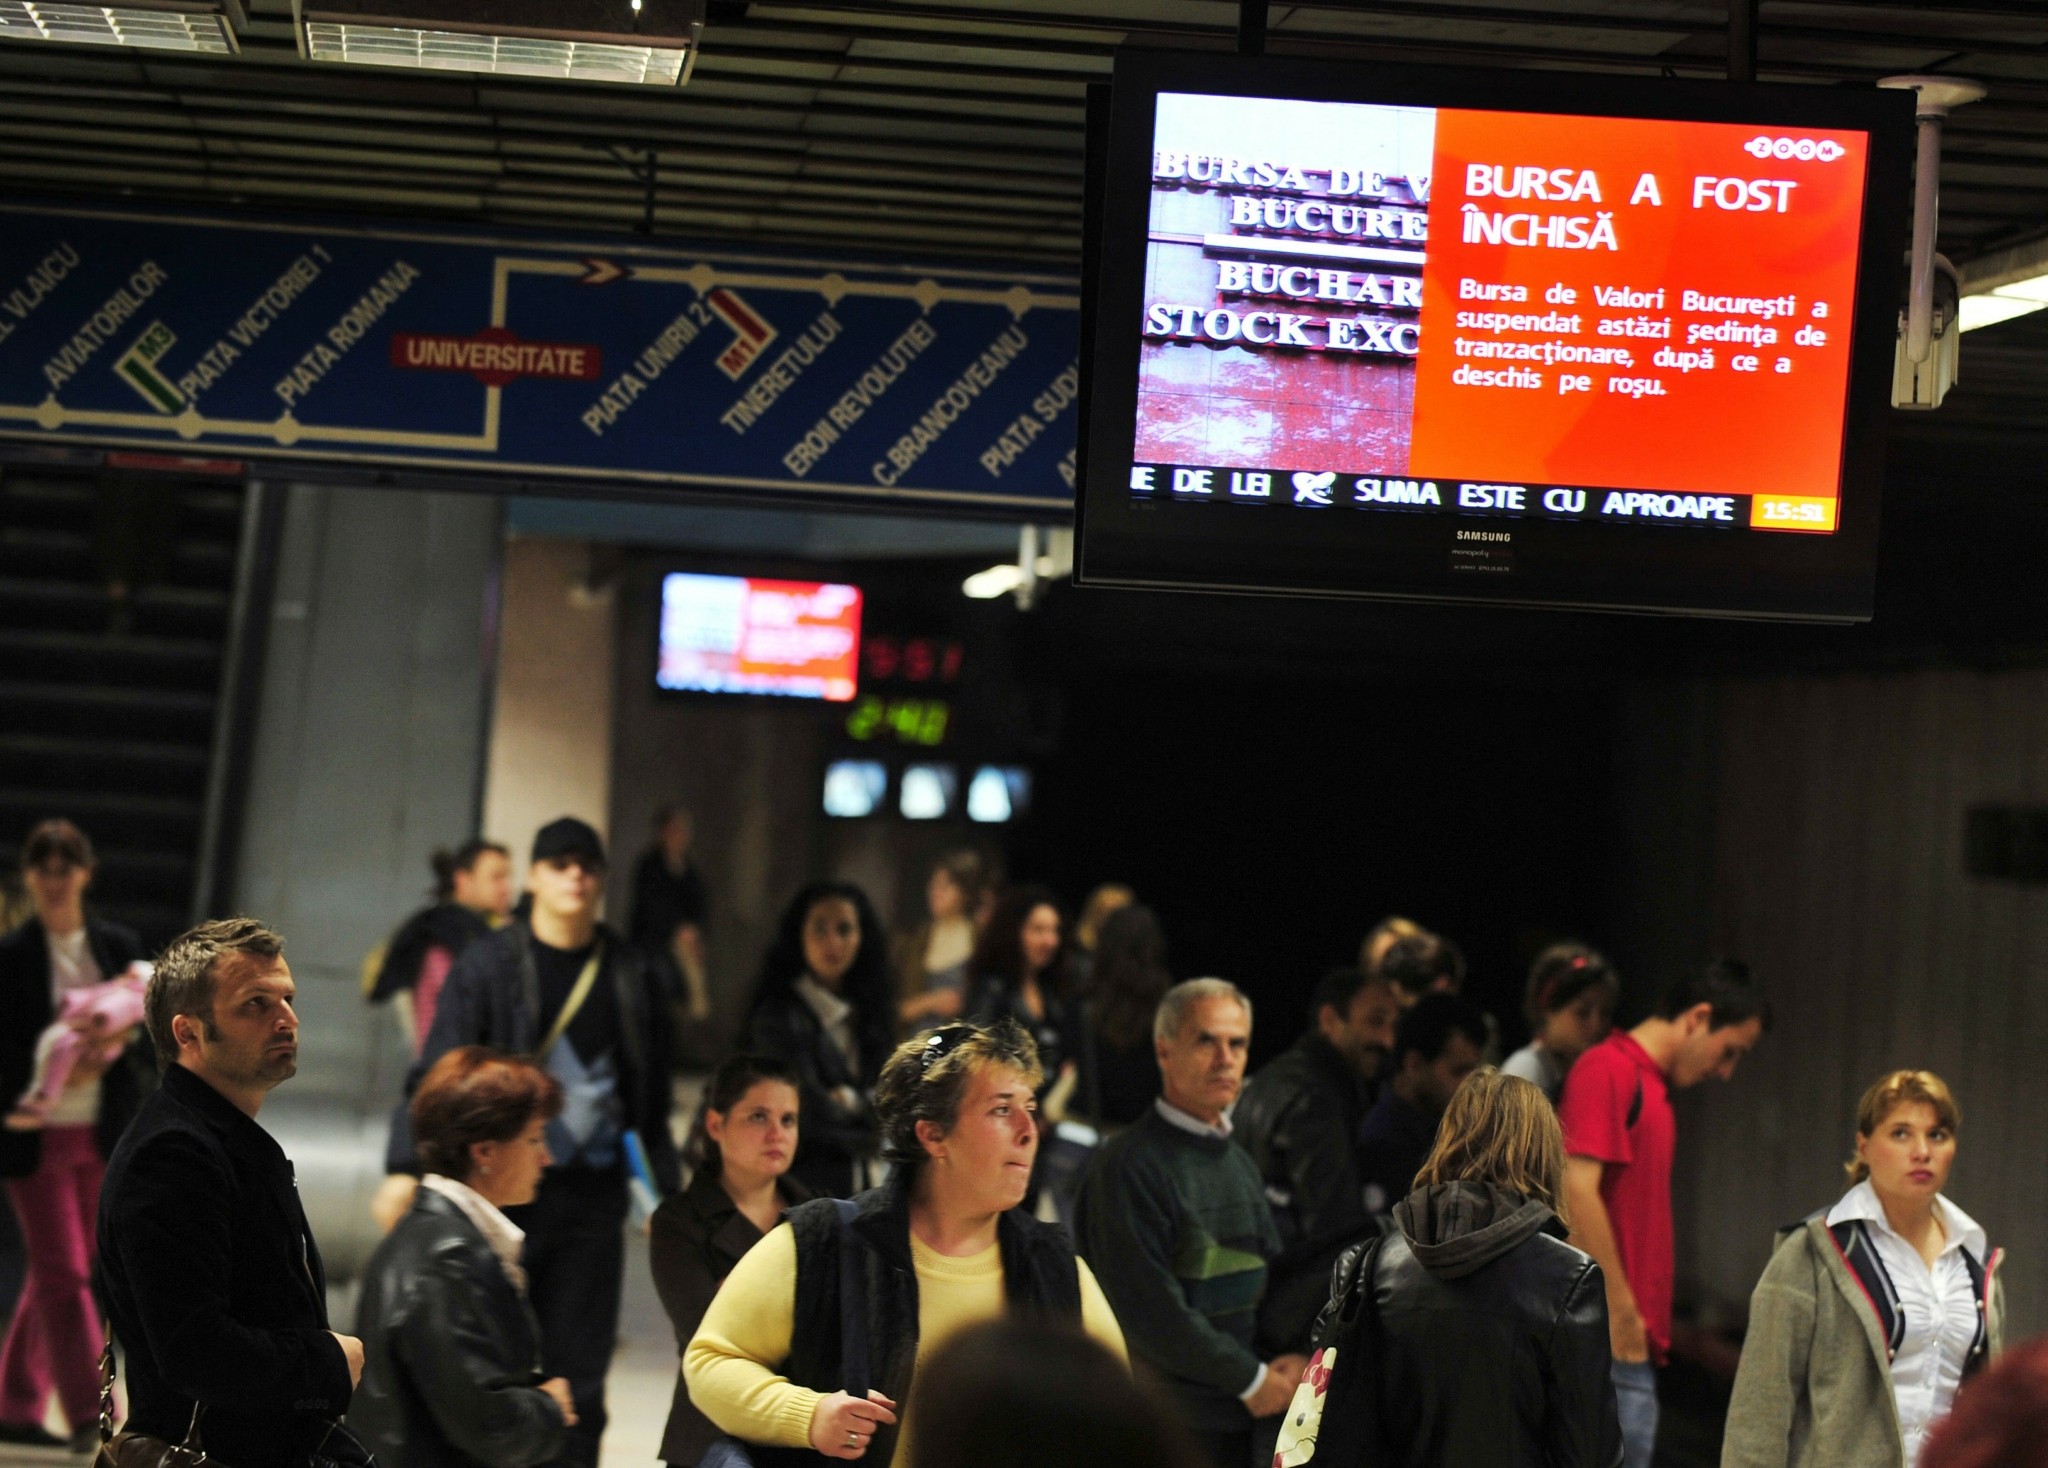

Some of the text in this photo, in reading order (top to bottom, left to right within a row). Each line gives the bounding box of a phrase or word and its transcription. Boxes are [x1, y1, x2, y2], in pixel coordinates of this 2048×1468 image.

[1754, 139, 1837, 159] ZOOM
[1155, 152, 1310, 191] BURSA
[1327, 167, 1388, 198] DE
[1465, 163, 1798, 213] BURSA A FOST
[1230, 196, 1428, 241] BUCURE
[1461, 203, 1618, 251] ÎNCHISĂ
[1, 240, 81, 320] VLAICU
[1216, 260, 1422, 307] BUCHAR
[1459, 278, 1528, 303] Bursa
[1545, 282, 1577, 304] de
[1594, 285, 1665, 310] Valori
[1811, 302, 1828, 318] a
[43, 259, 169, 391] AVIATORILOR
[136, 325, 172, 361] M3
[178, 341, 242, 400] PIATA
[230, 257, 323, 348] VICTORIEI
[274, 261, 421, 408] PIATA ROMANA
[1146, 303, 1421, 356] STOCK EXC
[1456, 309, 1581, 335] suspendat
[1597, 315, 1671, 340] astăzi
[1794, 326, 1826, 347] de
[407, 338, 586, 375] UNIVERSITATE
[580, 300, 715, 437] PIATA UNIRII 2
[719, 312, 844, 436] TINERETULUI
[721, 338, 758, 375] M1
[1452, 364, 1542, 389] deschis
[1559, 374, 1591, 394] pe
[1653, 347, 1715, 373] după
[1731, 354, 1758, 372] ce
[1775, 356, 1791, 373] a
[782, 318, 938, 480] EROII REVOLUTIEI
[871, 327, 1029, 488] C.BRANCOVEANU
[978, 413, 1046, 479] PIATA
[1172, 469, 1213, 494] DE
[1230, 472, 1271, 497] LEI
[1354, 478, 1441, 506] SUMA
[1458, 483, 1526, 510] ESTE
[1543, 487, 1586, 513] CU
[1602, 491, 1735, 521] APROAPE
[1762, 501, 1825, 522] 15:51
[1456, 530, 1511, 543] SAMSUNG
